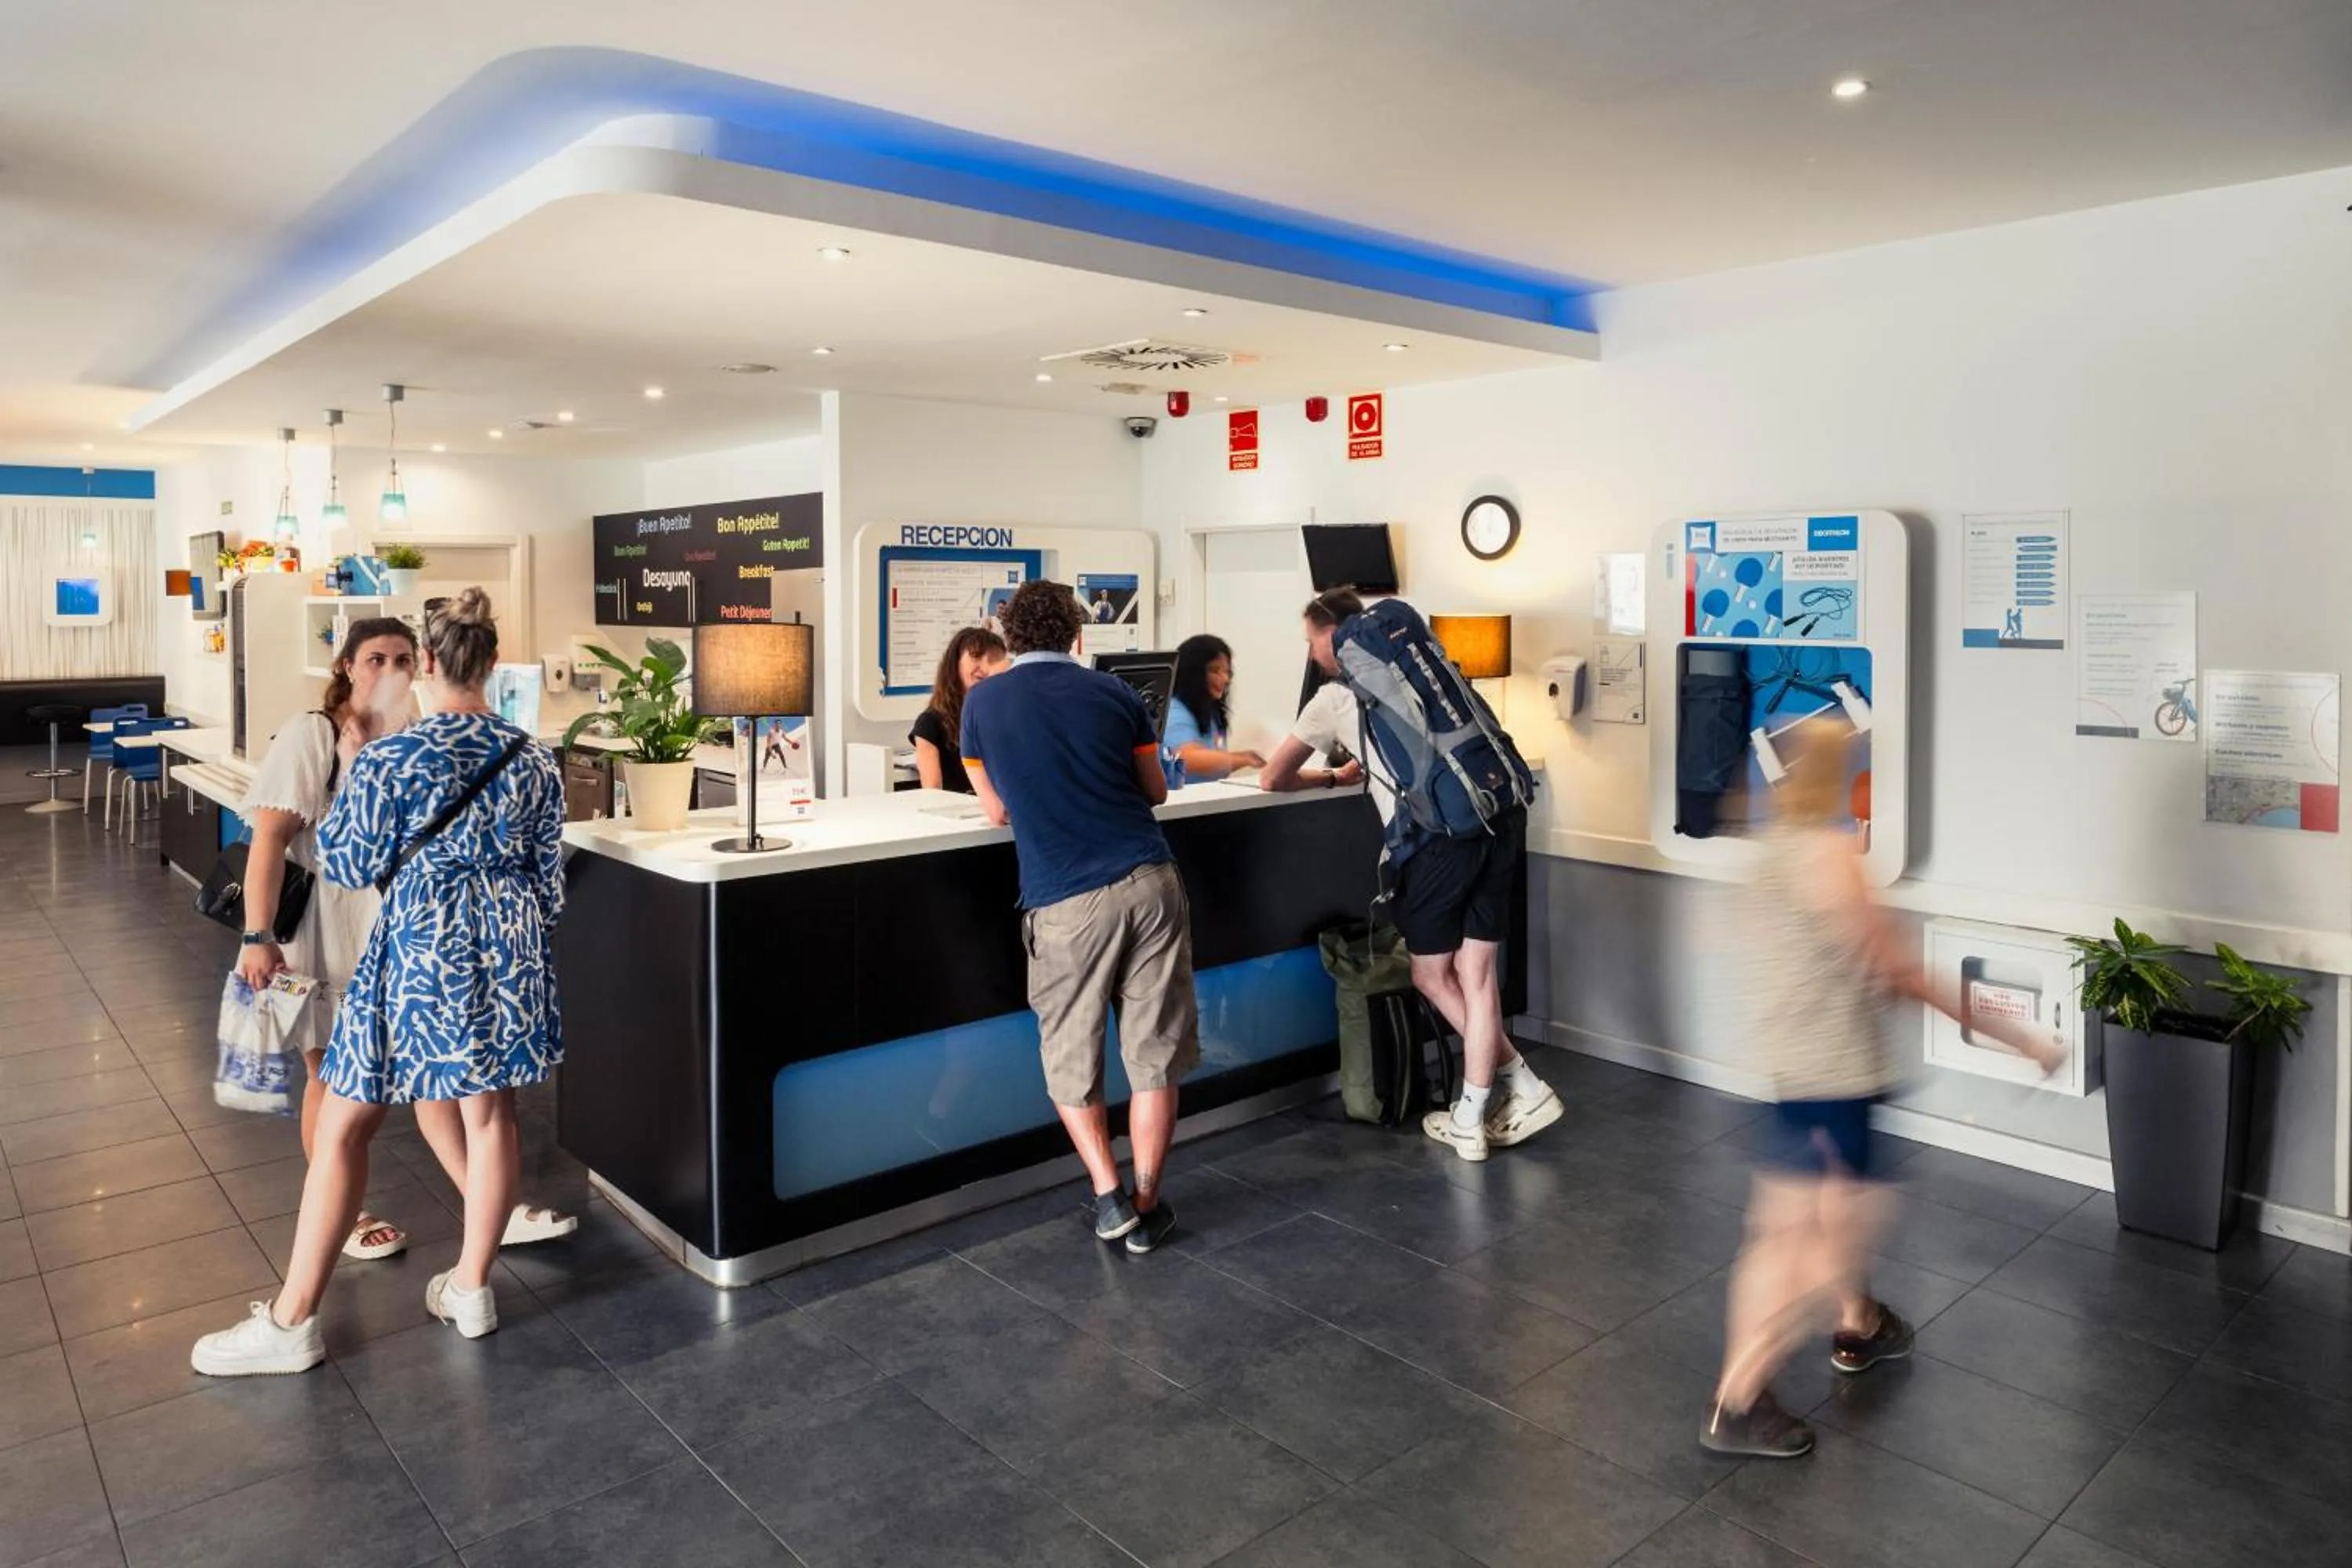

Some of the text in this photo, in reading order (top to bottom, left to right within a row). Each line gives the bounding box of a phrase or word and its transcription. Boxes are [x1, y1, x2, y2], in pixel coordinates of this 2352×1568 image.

[717, 517, 736, 534] Bon
[901, 524, 1013, 547] RECEPCION
[739, 564, 775, 579] Breakfast
[720, 604, 739, 619] Petit
